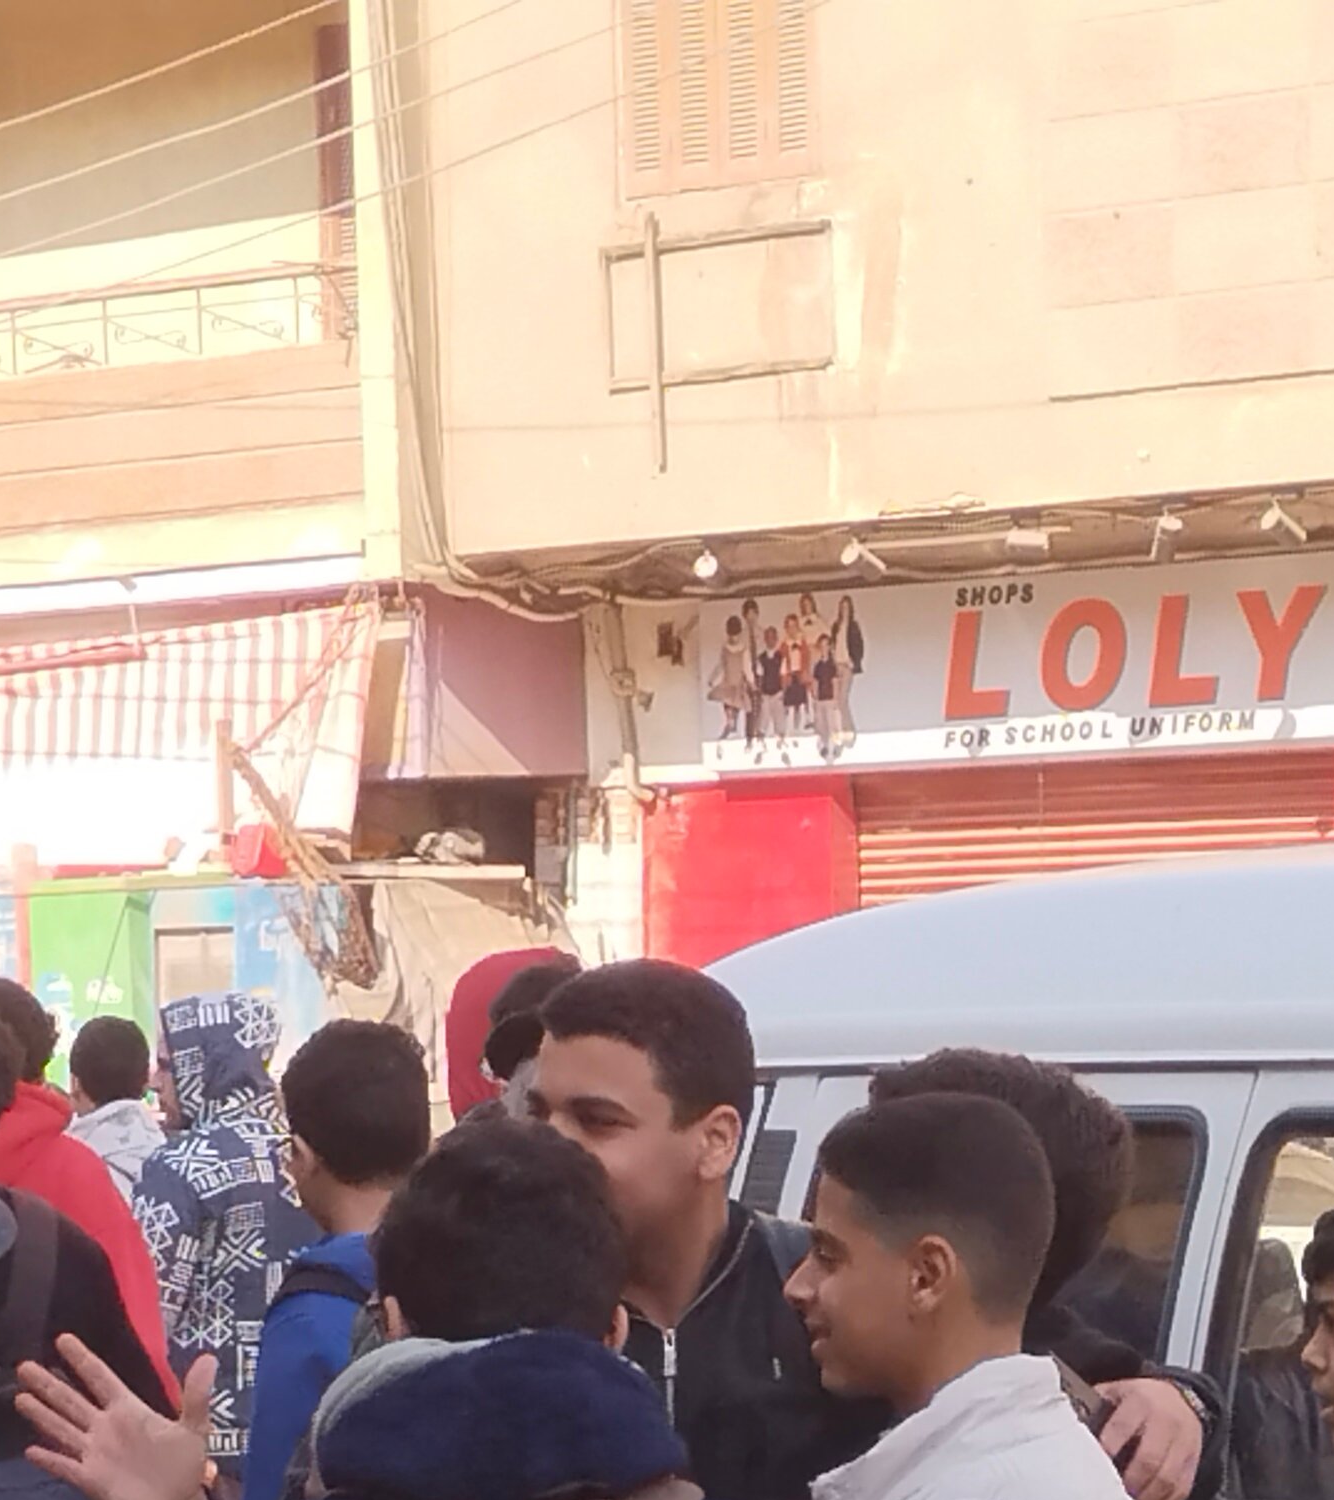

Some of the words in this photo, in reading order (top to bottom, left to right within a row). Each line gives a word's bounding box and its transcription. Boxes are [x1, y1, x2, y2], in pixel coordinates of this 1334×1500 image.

[955, 582, 1035, 608] SHOPS
[944, 584, 1328, 721] LOLY
[944, 729, 991, 750] FOR
[1005, 718, 1114, 746] SCHOOL
[1129, 709, 1257, 737] UNIFORM
